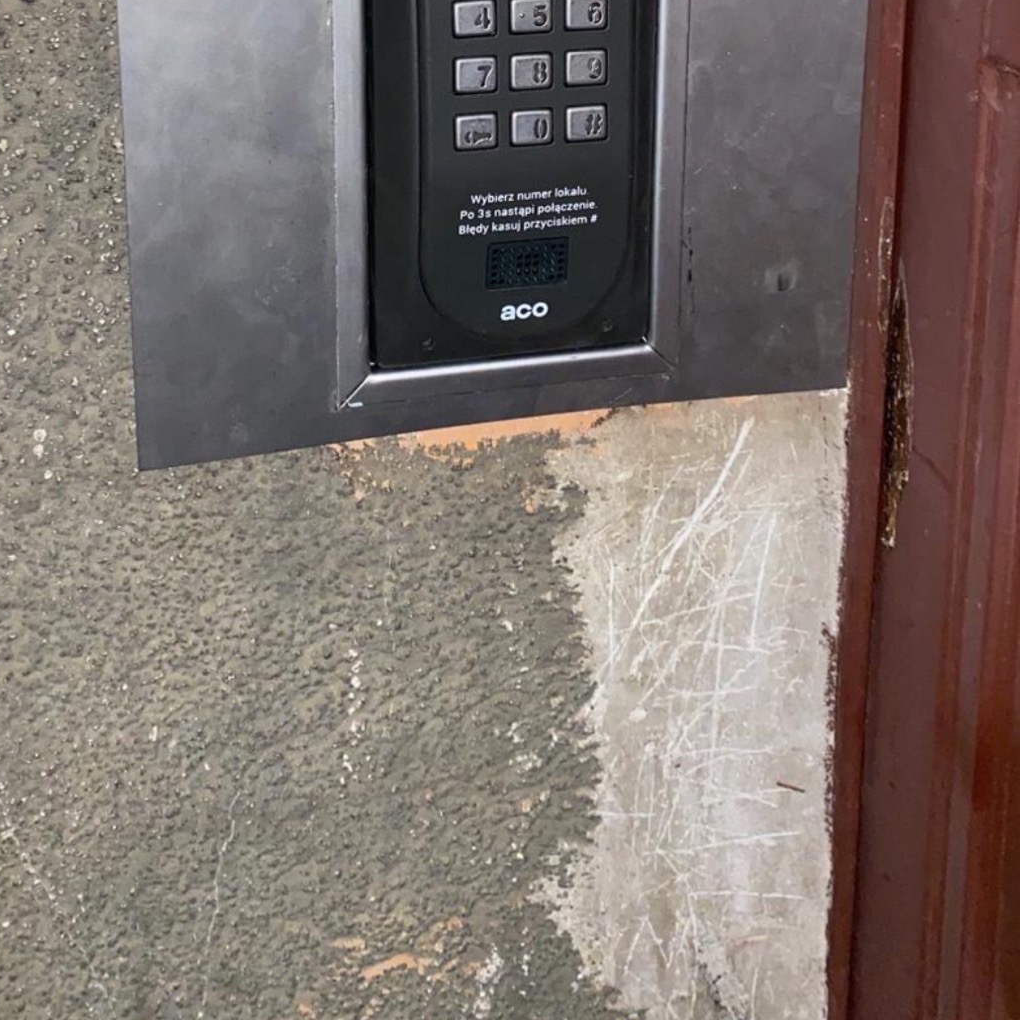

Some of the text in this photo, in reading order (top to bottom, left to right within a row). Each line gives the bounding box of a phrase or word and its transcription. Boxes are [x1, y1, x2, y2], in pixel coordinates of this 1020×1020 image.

[474, 7, 491, 29] 4
[533, 4, 548, 27] 5
[587, 1, 602, 24] 6
[477, 64, 492, 87] 7
[533, 61, 548, 84] 8
[587, 57, 602, 80] 9
[533, 118, 548, 140] 0
[470, 192, 514, 206] Wybierz
[517, 190, 552, 201] numer
[460, 210, 475, 220] Po
[477, 208, 491, 219] 3s
[494, 204, 535, 218] nastąpi
[458, 223, 489, 236] Błędy
[491, 220, 521, 233] kasuj
[524, 215, 588, 231] przyciskiem
[500, 301, 549, 321] aco
